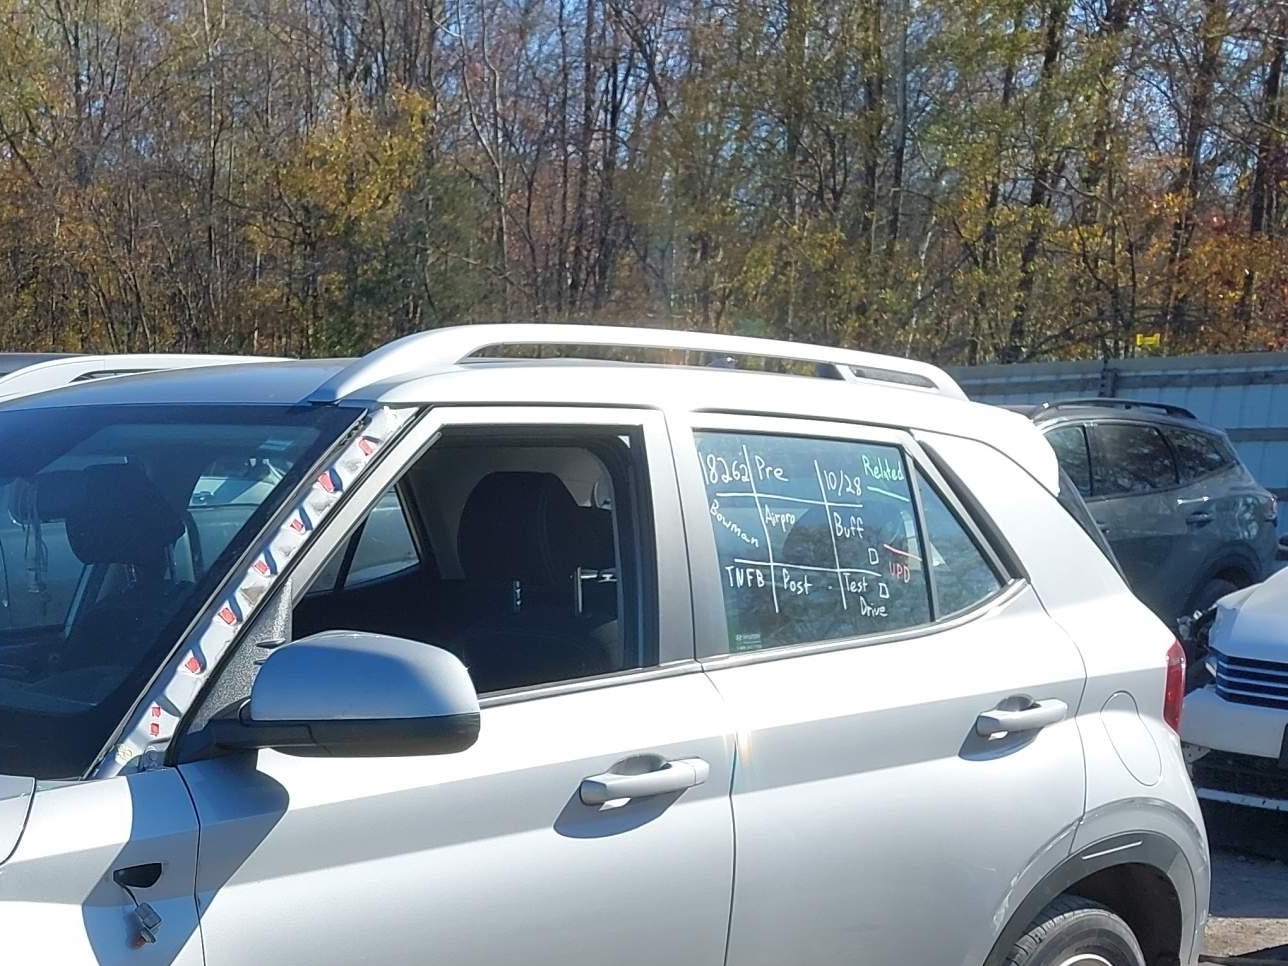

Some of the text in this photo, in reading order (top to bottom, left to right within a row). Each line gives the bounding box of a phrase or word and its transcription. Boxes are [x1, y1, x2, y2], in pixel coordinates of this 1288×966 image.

[754, 455, 789, 482] Pre
[824, 470, 862, 497] 10/28
[709, 499, 760, 548] Bowman
[834, 511, 865, 538] Buff
[782, 570, 813, 594] Post
[844, 573, 868, 593] Test
[859, 596, 889, 617] Drive
